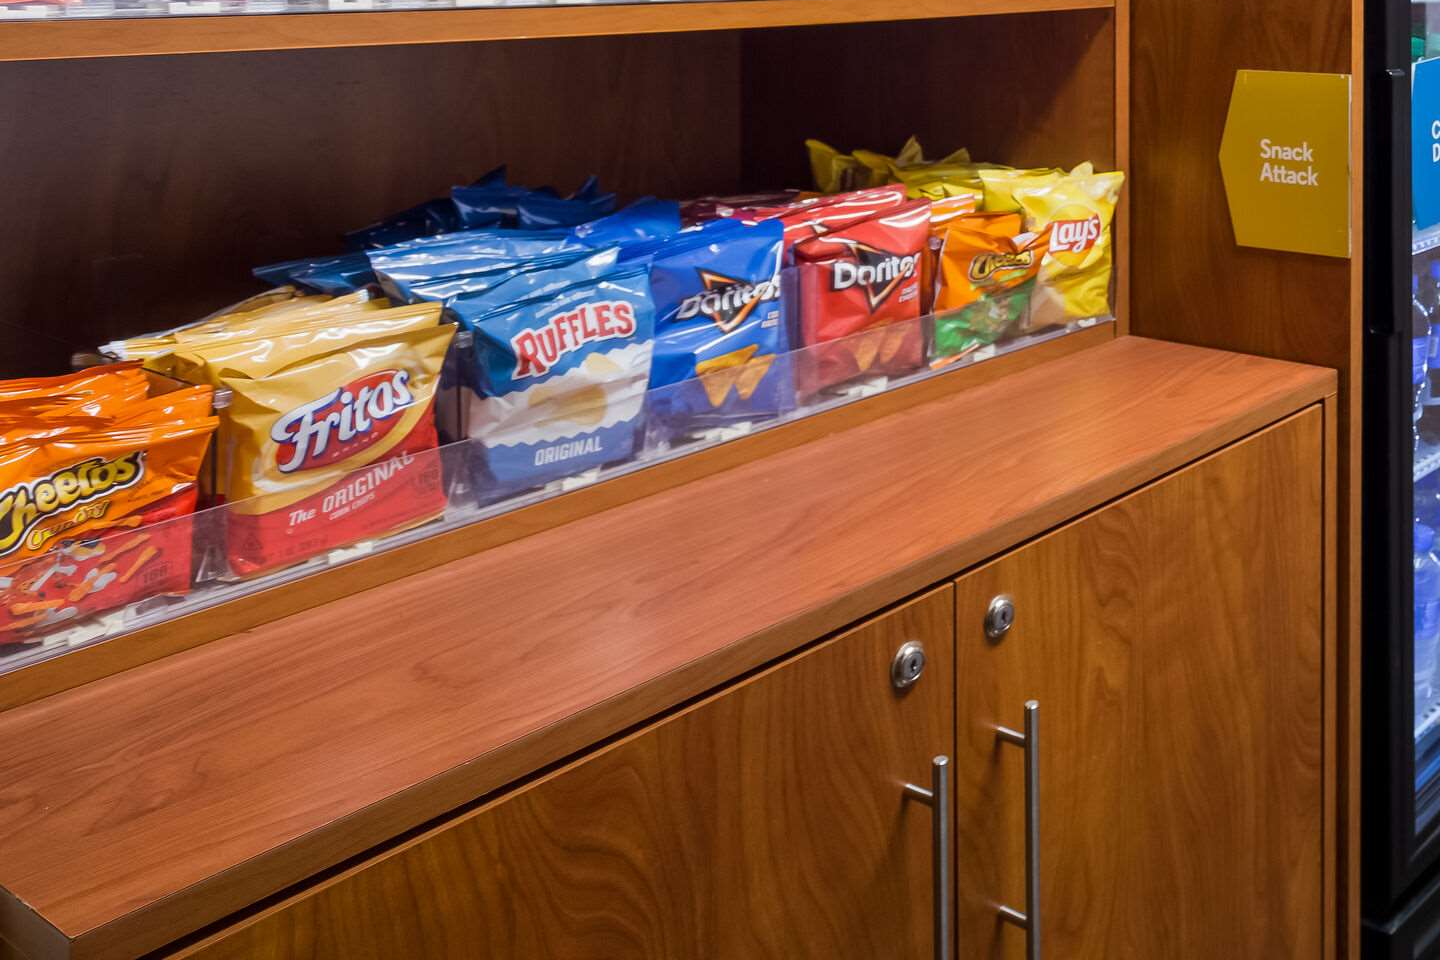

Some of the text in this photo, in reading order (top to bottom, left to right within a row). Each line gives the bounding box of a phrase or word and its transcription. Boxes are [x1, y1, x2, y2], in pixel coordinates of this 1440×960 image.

[1260, 138, 1314, 162] Snack
[1260, 162, 1319, 186] Attack
[1048, 217, 1099, 253] Lay's
[513, 301, 635, 378] RUFFLES
[271, 368, 413, 473] Fritos
[534, 436, 603, 467] ORIGINAL
[288, 451, 415, 527] The ORIGINAL
